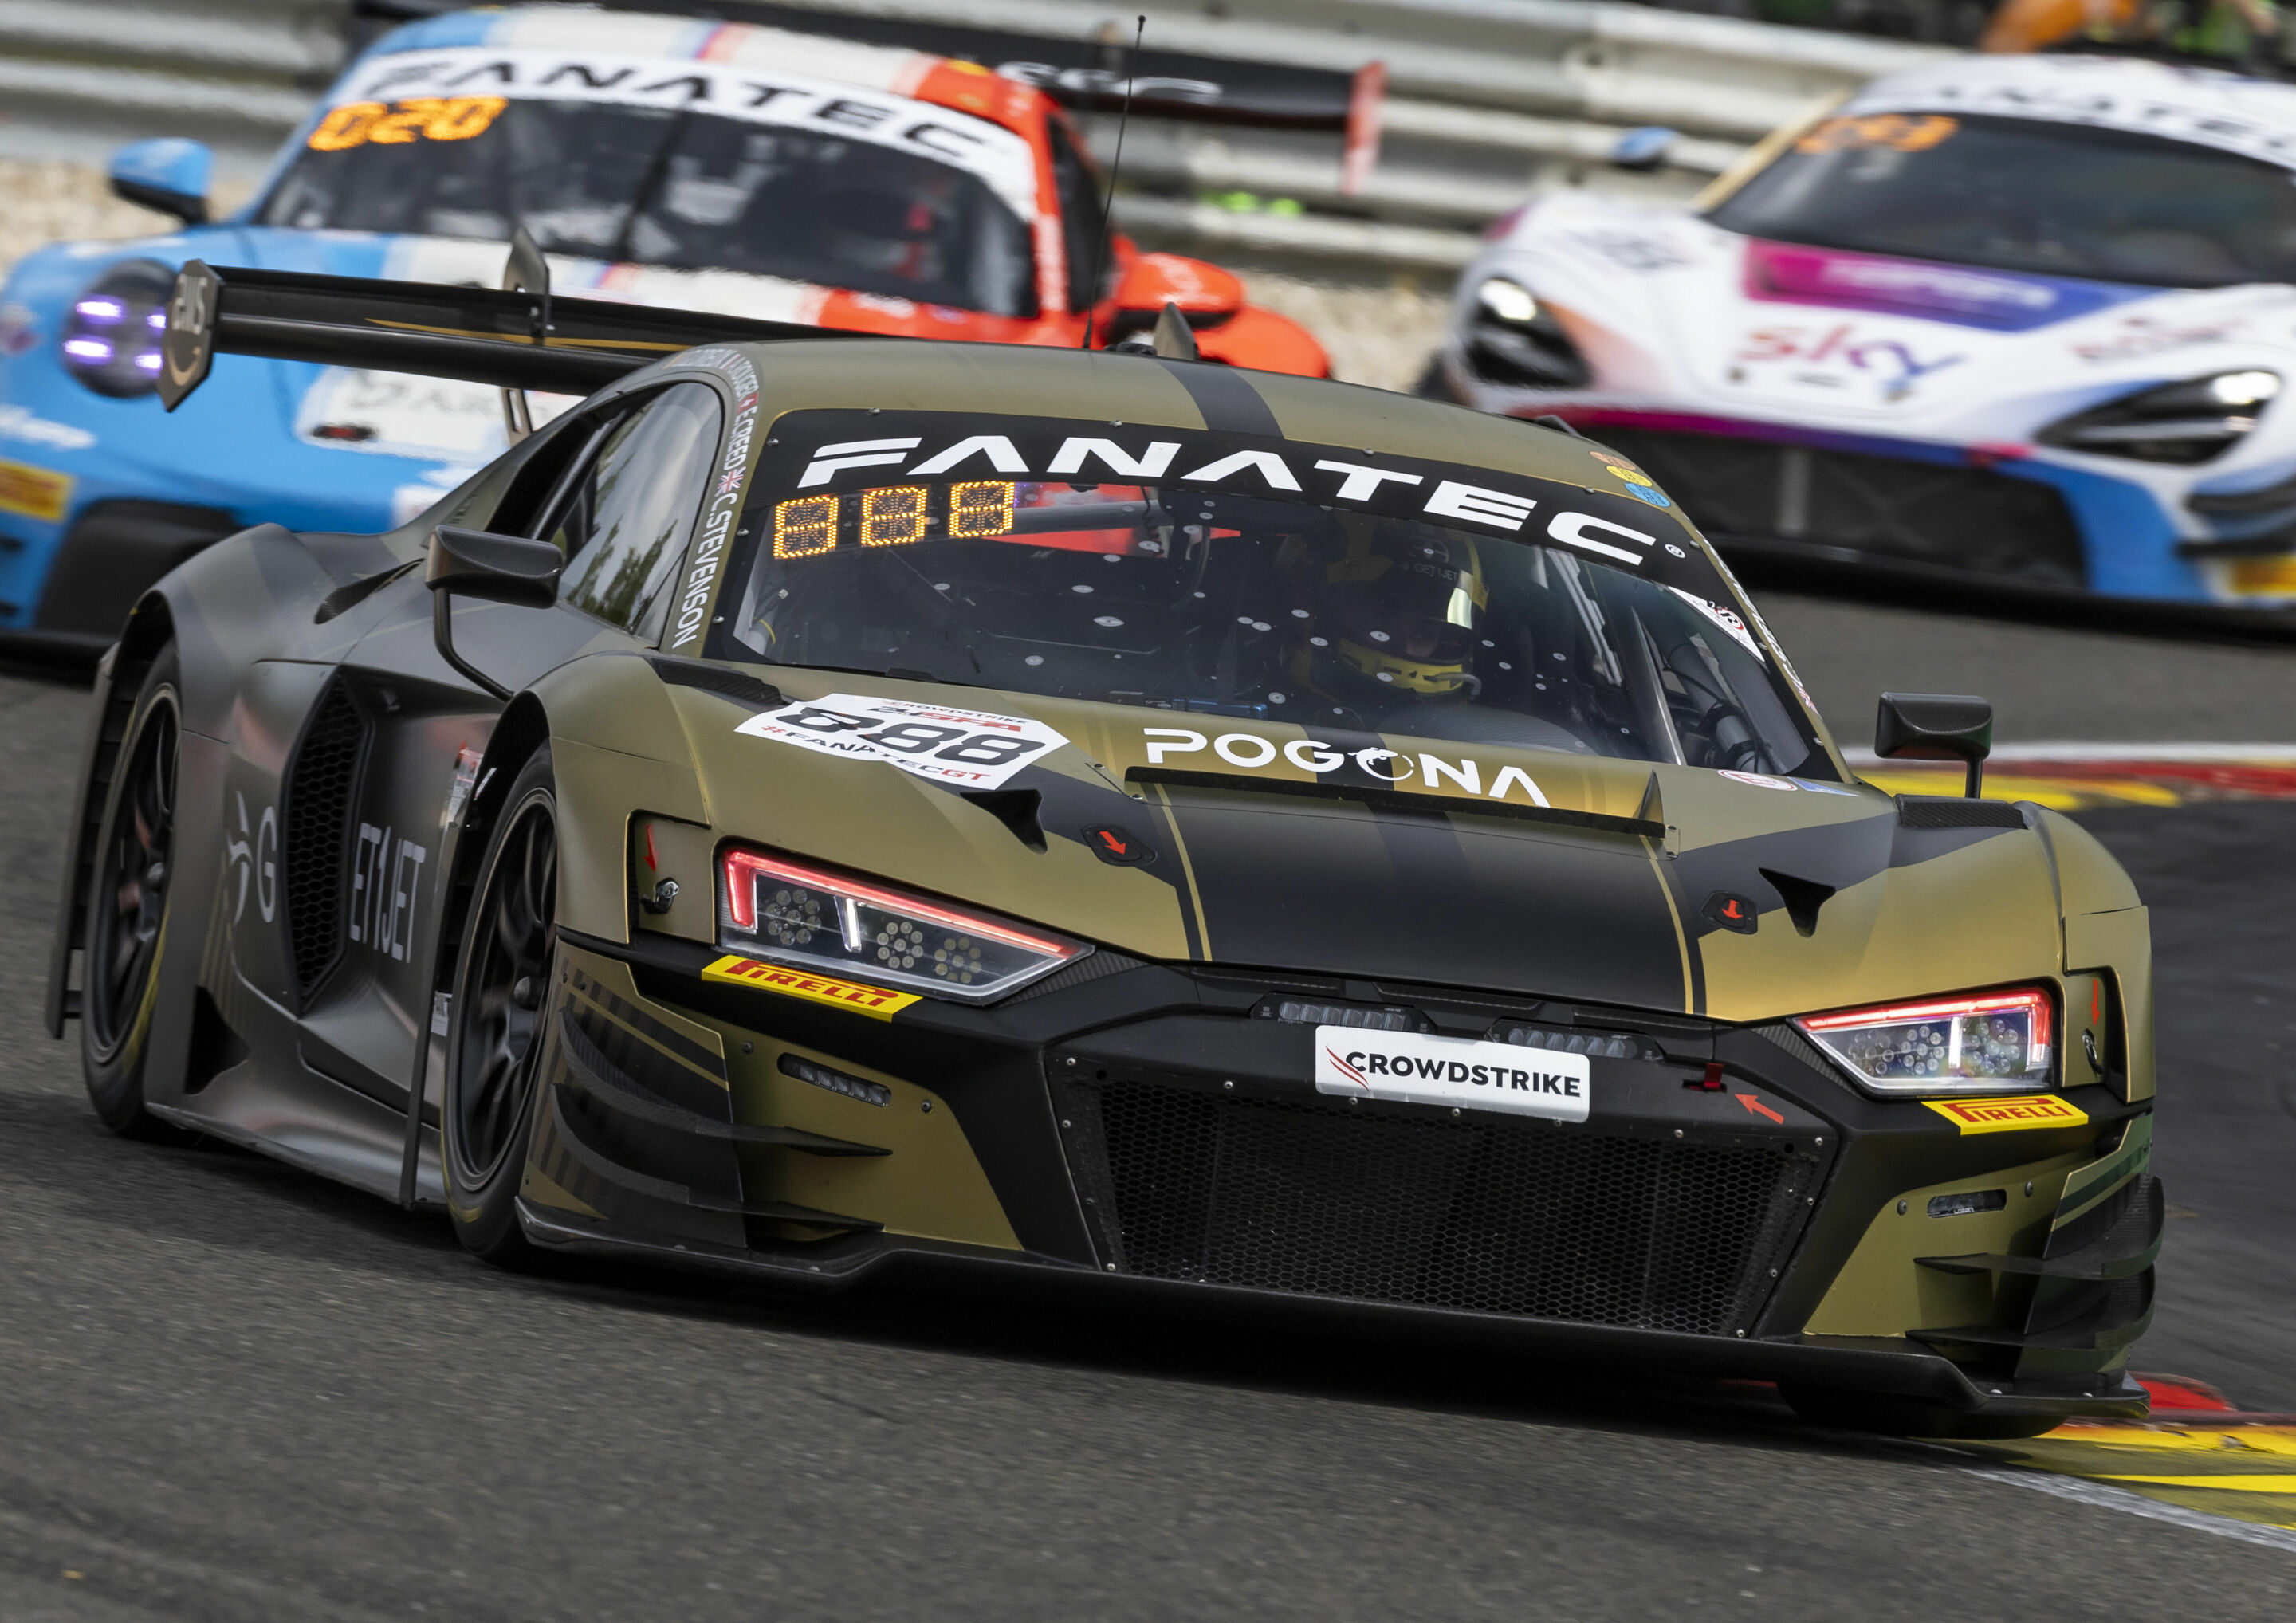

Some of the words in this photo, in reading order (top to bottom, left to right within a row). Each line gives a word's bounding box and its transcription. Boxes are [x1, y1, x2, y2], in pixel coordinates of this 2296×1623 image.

[309, 96, 508, 151] 020
[365, 61, 987, 159] FANATEC
[723, 406, 758, 471] E.CREED
[773, 481, 1015, 559] 888
[797, 435, 1657, 565] FANATEC
[671, 492, 738, 650] C.STEVENSON
[776, 706, 1046, 766] 888
[1143, 727, 1550, 808] POGONA
[725, 959, 899, 1007] PIRELLI
[1345, 1051, 1581, 1098] CROWDSTRIKE
[1941, 1098, 2074, 1122] PIRELLI
